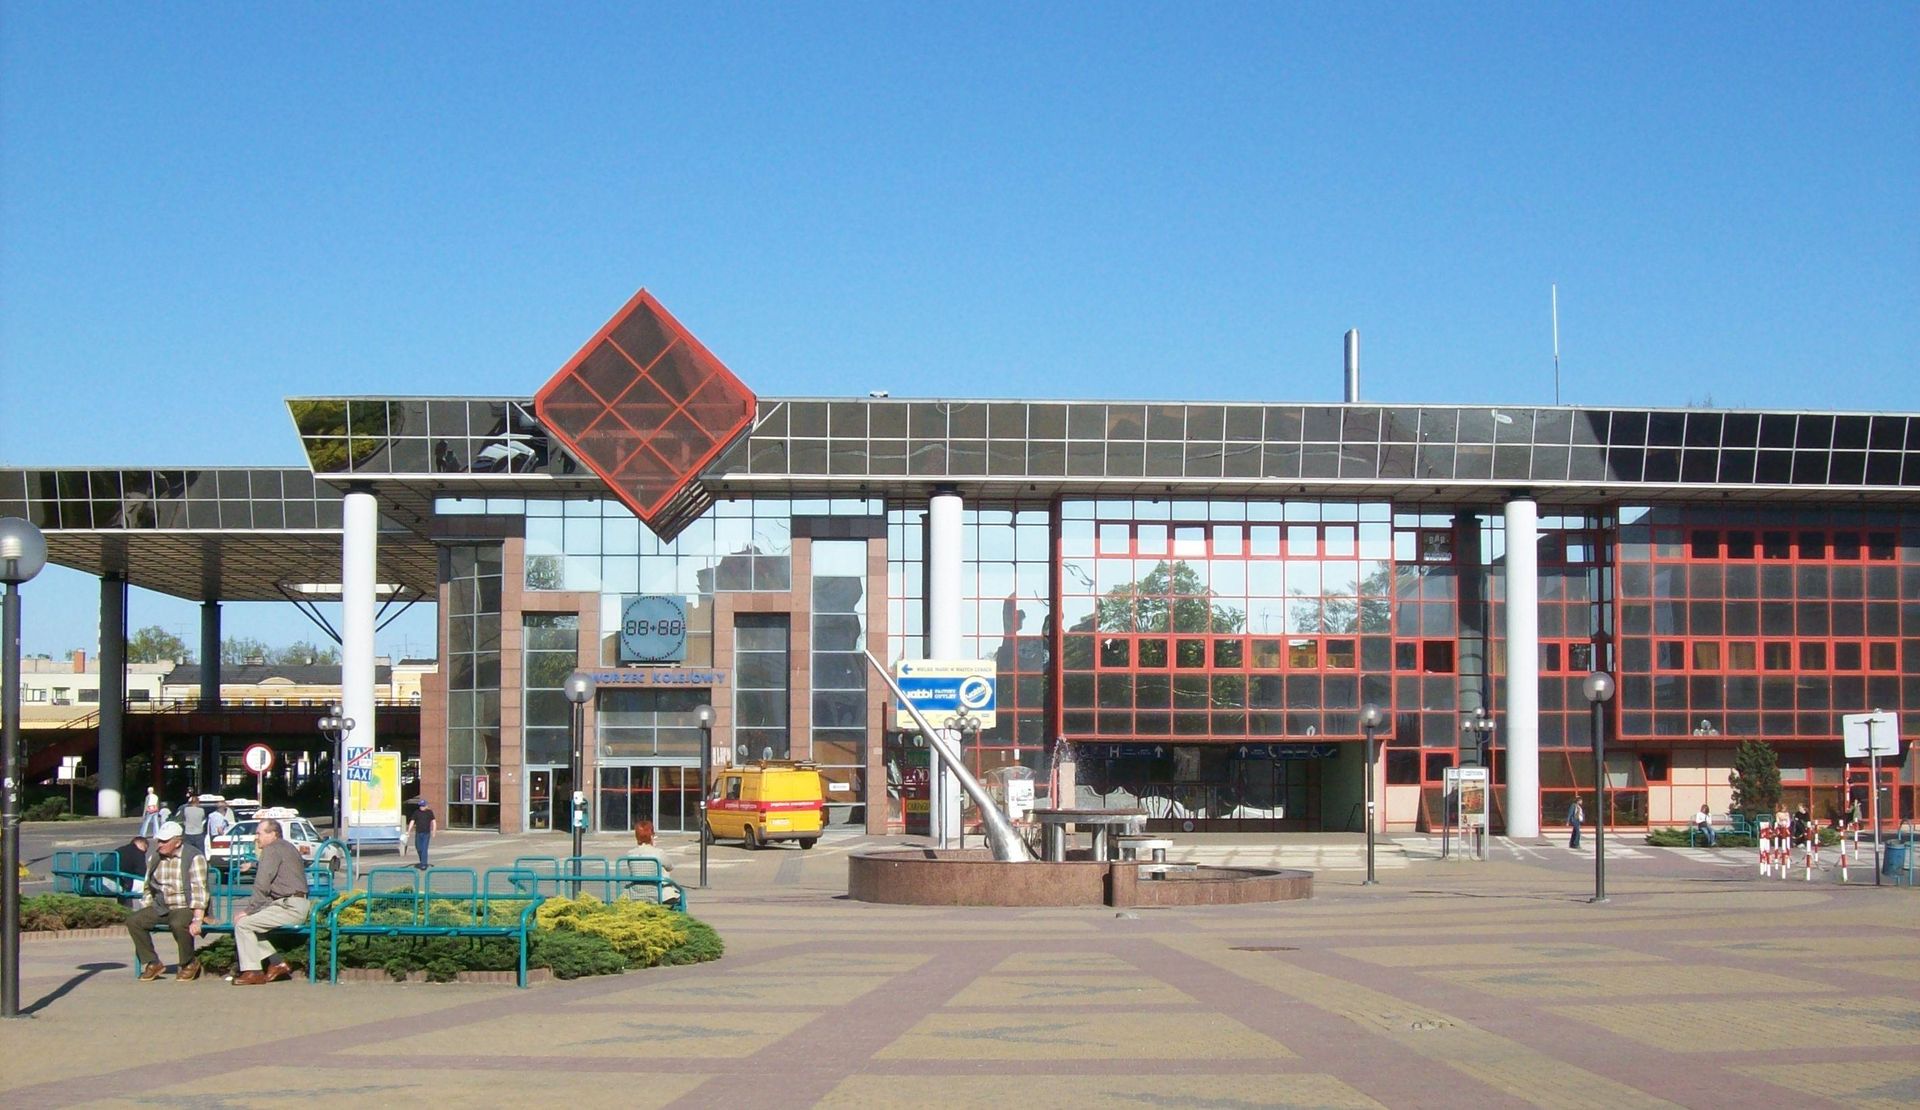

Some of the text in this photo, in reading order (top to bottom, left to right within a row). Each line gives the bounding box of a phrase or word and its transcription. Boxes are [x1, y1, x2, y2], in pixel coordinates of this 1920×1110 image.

[592, 672, 726, 684] WORZEC KOLEJOWY
[348, 768, 372, 781] TAXI
